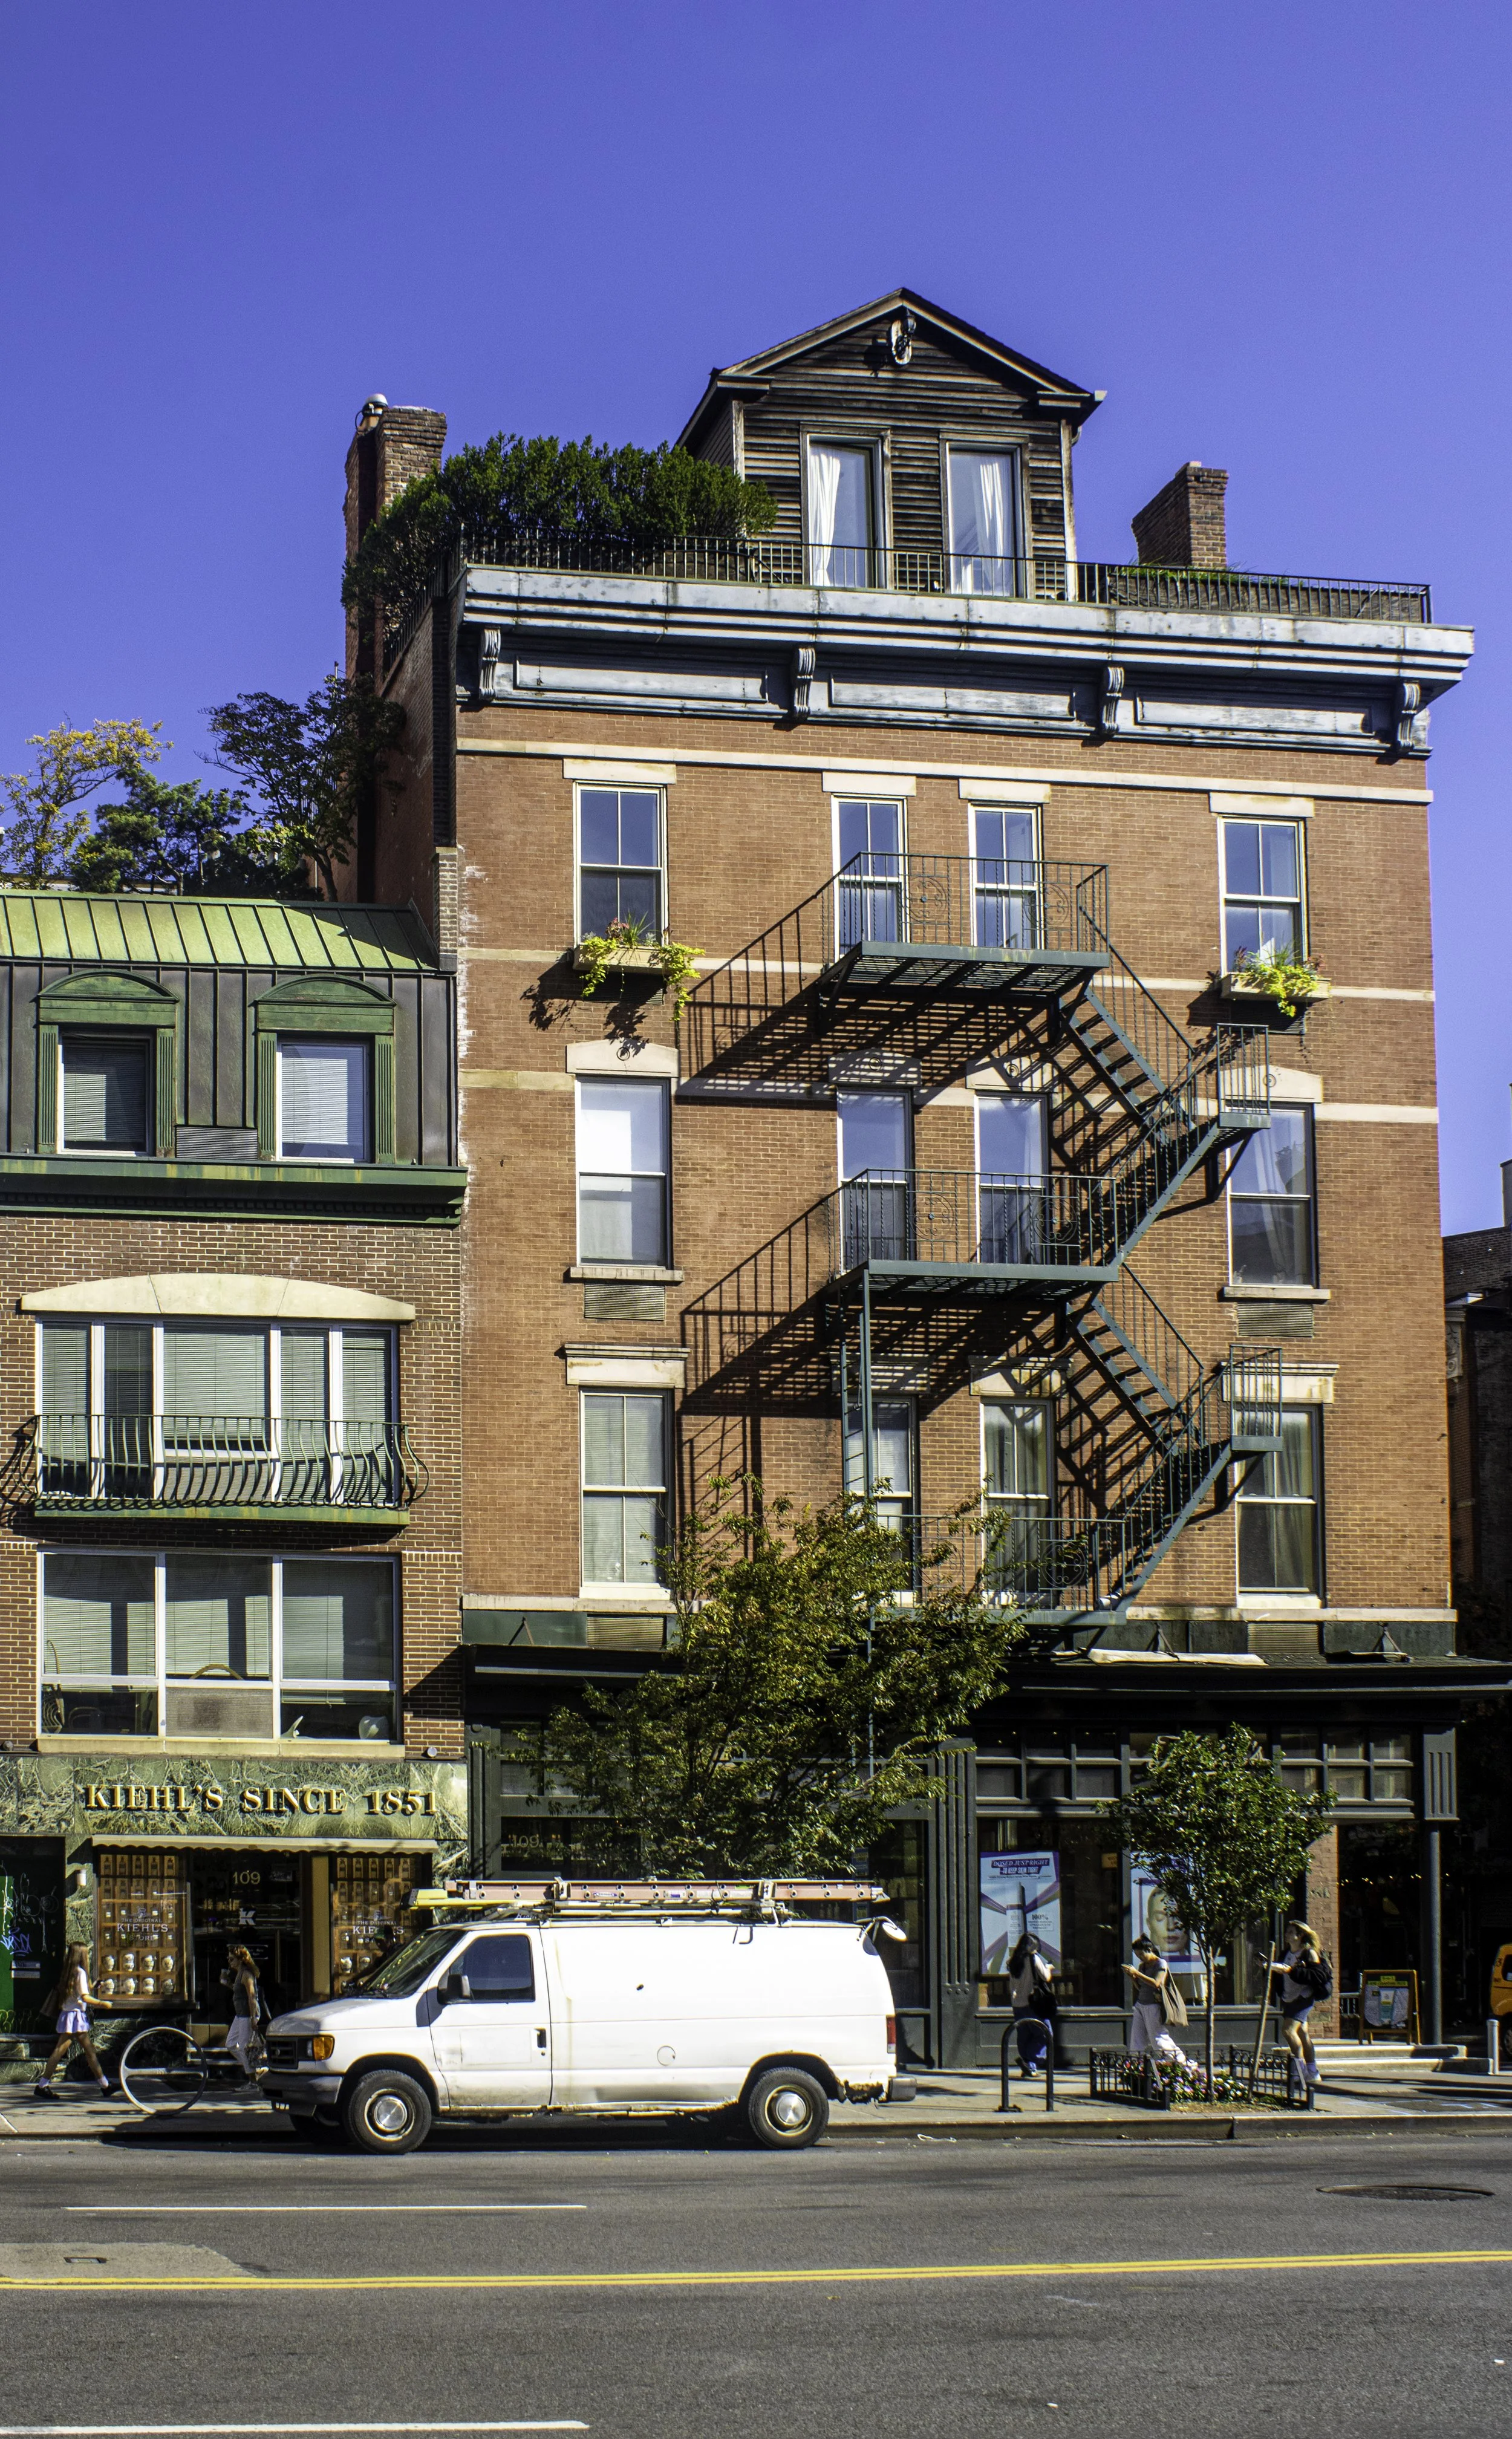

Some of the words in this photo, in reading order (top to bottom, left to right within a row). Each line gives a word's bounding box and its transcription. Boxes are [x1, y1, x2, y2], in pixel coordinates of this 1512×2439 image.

[86, 1784, 224, 1811] KIEHL'S
[243, 1786, 348, 1812] SINCE
[366, 1788, 439, 1814] 1851
[512, 1835, 539, 1848] 109
[232, 1871, 261, 1884] 109
[117, 1923, 169, 1932] KIEHL'S
